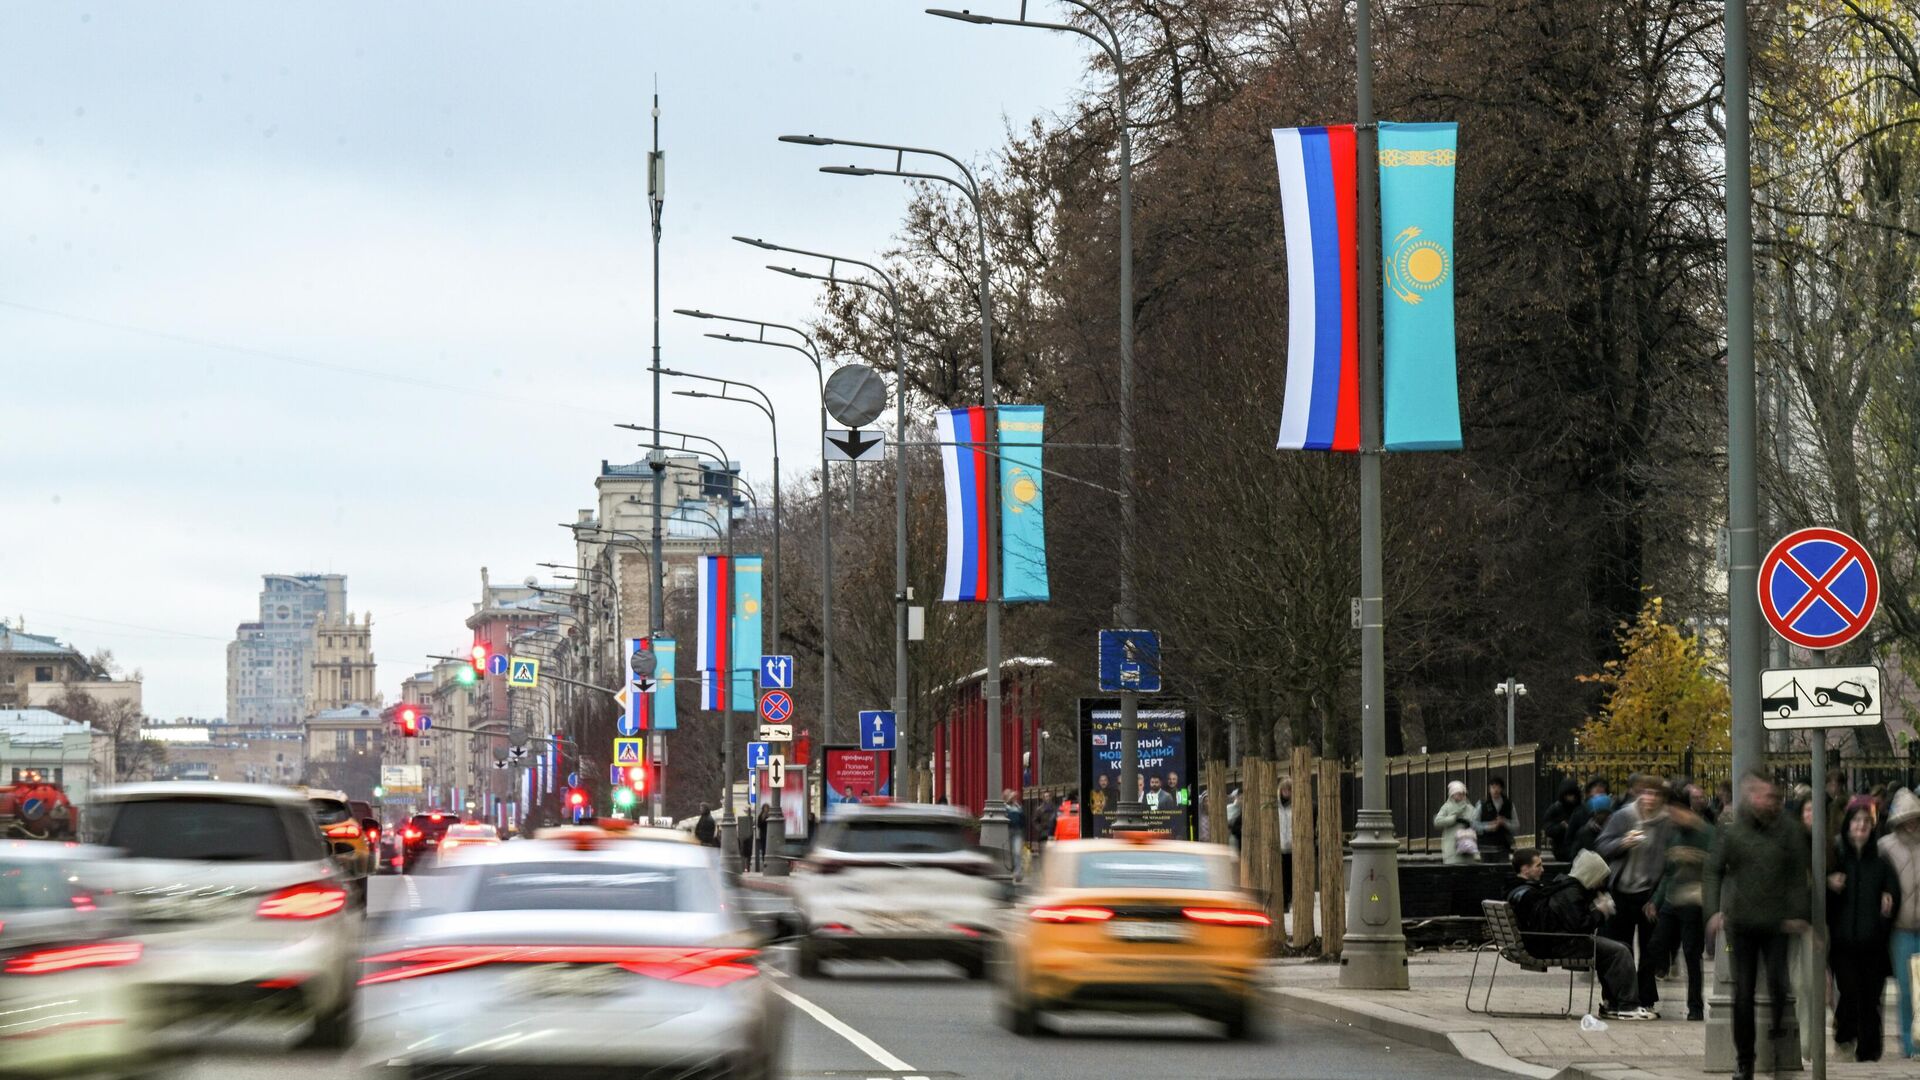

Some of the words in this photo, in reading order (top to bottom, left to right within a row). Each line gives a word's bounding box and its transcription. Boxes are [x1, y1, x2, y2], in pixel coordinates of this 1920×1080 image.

[1110, 737, 1163, 750] ГЛНЫЙ
[1100, 745, 1174, 760] НОВОДНИЙ
[1111, 758, 1163, 769] КОЦЕРТ
